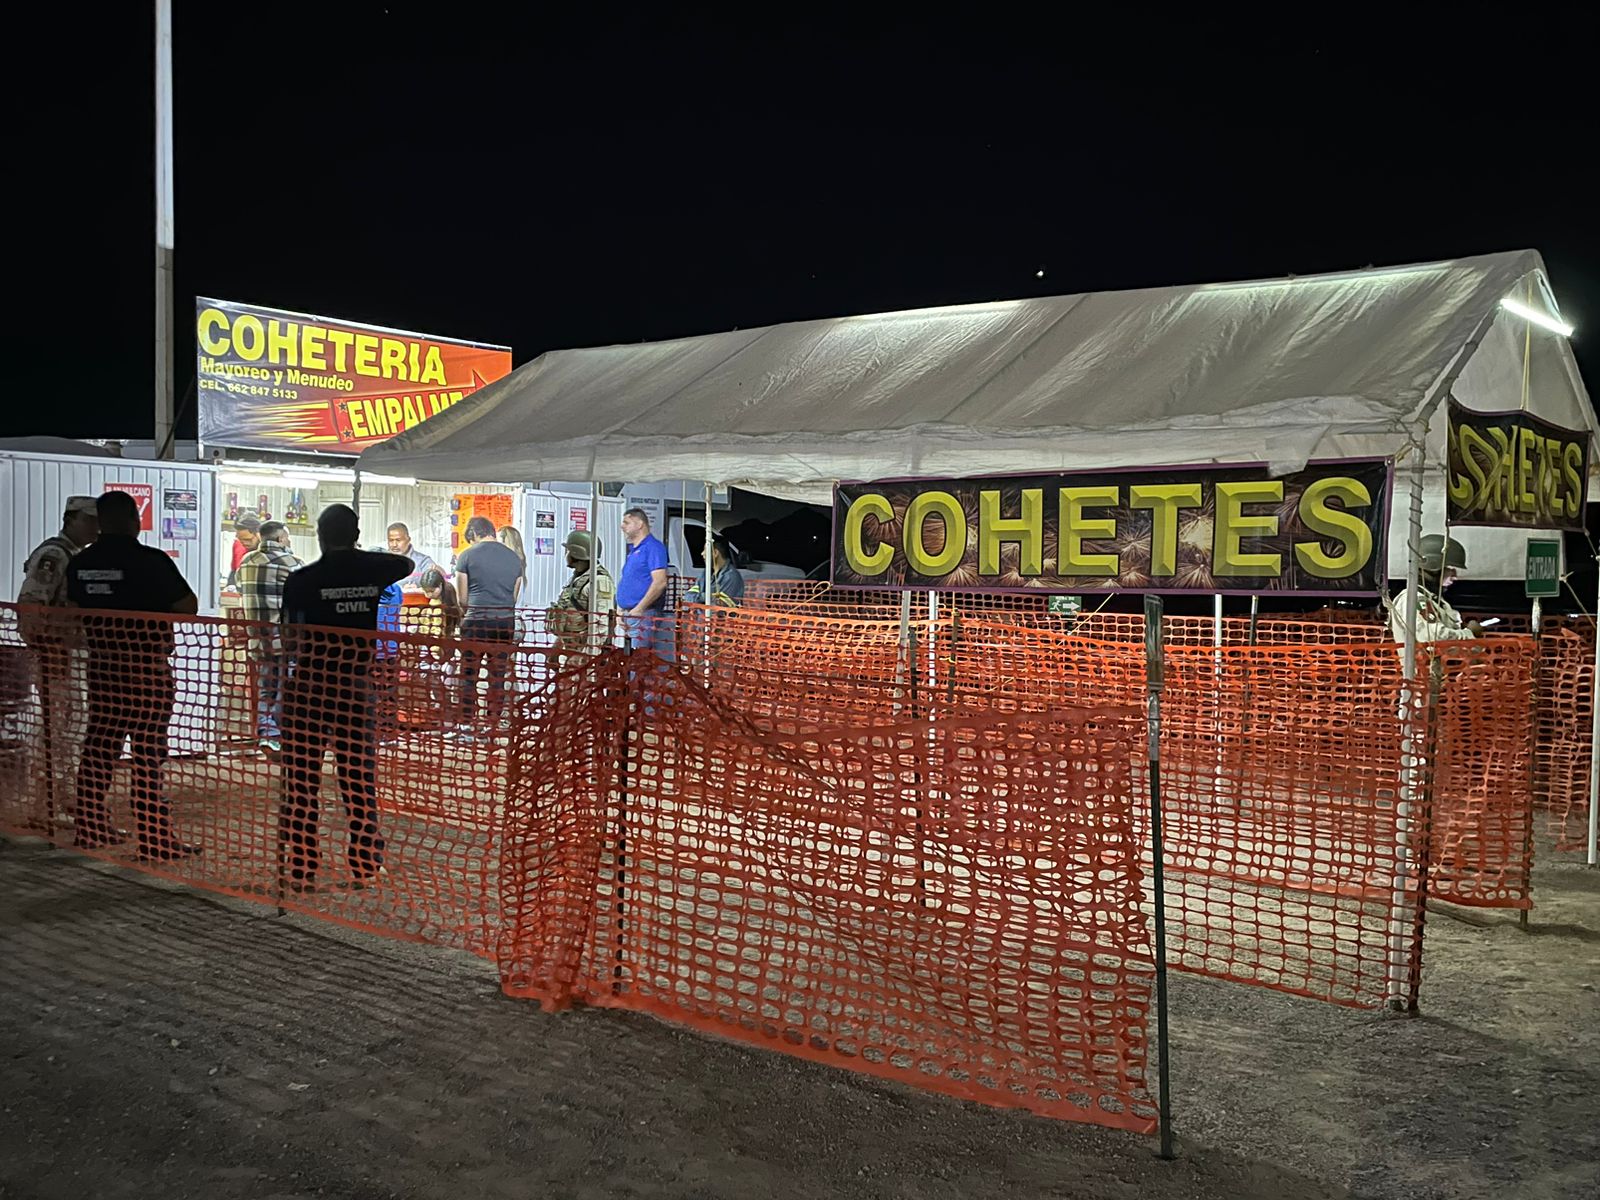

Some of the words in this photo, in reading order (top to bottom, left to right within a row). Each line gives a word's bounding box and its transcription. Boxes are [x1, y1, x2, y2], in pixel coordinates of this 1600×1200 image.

[197, 308, 447, 386] COHETERIA
[200, 356, 270, 381] Mayoreo
[274, 370, 283, 386] y
[286, 368, 354, 392] Menudeo
[199, 379, 225, 391] CEL.
[250, 385, 270, 396] 847
[272, 388, 298, 400] 5133
[844, 476, 1373, 578] COHETES
[1529, 556, 1556, 580] ENTRADA
[336, 601, 370, 613] CIVIL
